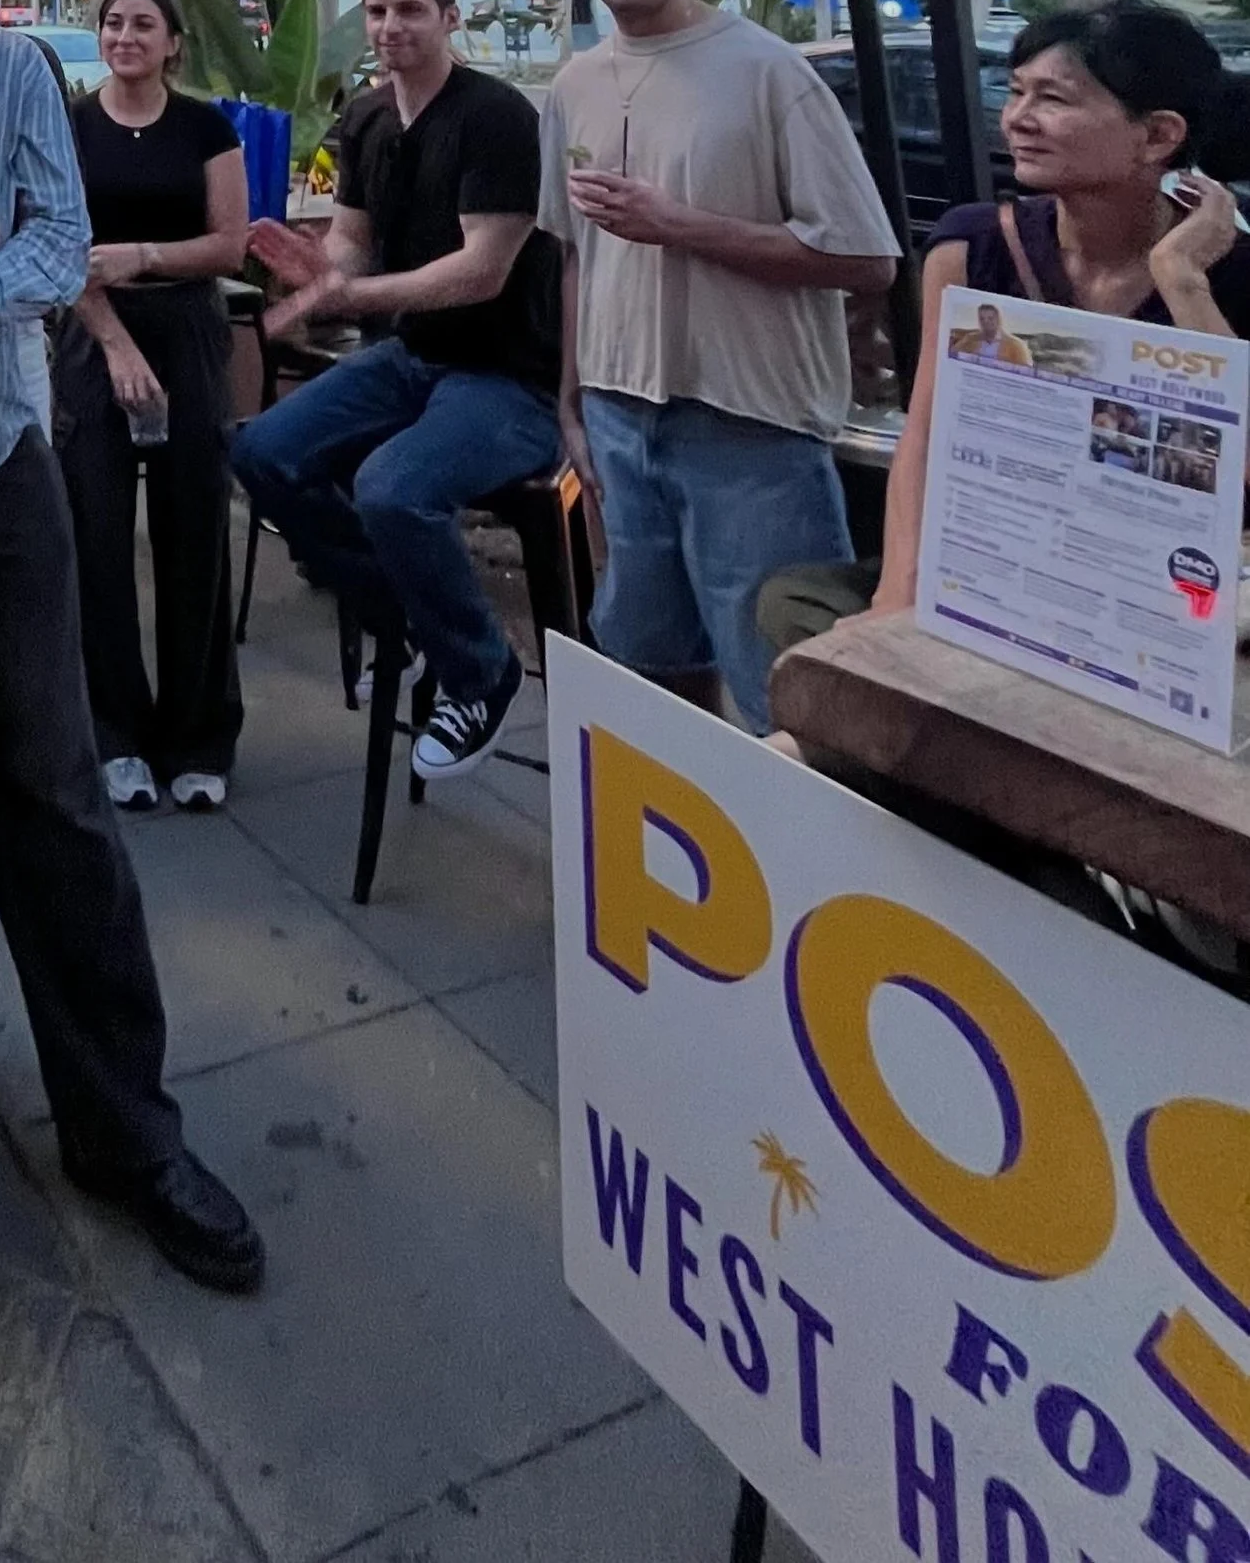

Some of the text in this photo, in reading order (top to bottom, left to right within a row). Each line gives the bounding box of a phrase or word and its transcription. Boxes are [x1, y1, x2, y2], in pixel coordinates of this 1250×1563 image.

[1131, 341, 1228, 379] POST
[585, 1102, 835, 1459] WEST
[942, 1299, 1250, 1563] FOR
